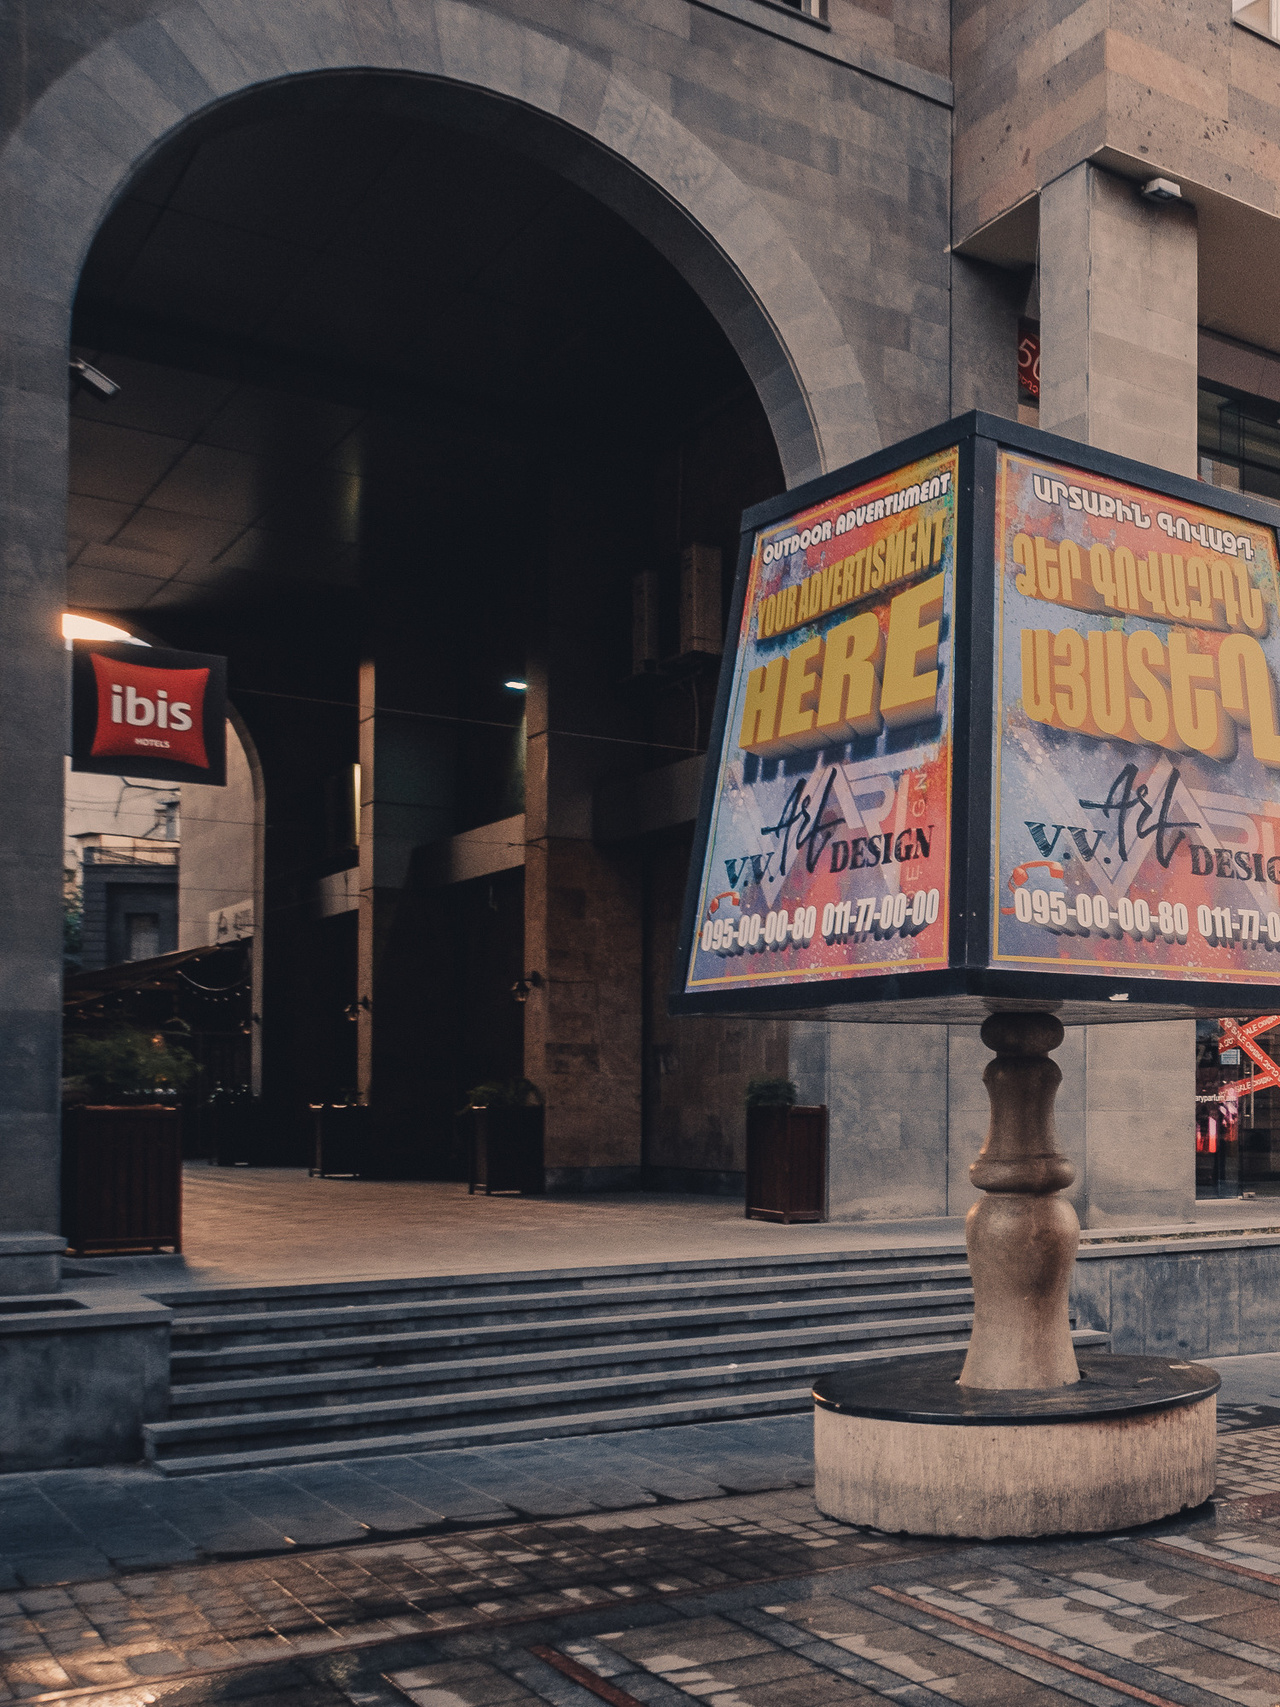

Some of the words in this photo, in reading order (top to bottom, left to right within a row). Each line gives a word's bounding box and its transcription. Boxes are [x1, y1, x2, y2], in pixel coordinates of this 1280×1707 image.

[762, 519, 833, 566] OUTDOOR
[835, 471, 951, 540] ADVERTISMENT
[757, 584, 799, 640] YOUR
[797, 508, 947, 624] ADVERTISMENT
[739, 572, 945, 752] HERE
[111, 683, 193, 732] ibis
[134, 737, 171, 749] HOTELS
[829, 824, 935, 874] DESIGN
[701, 905, 817, 953] 095-00-00-80
[821, 888, 940, 938] 011-77-00-00
[1014, 887, 1190, 936] 095-00-00-80
[1243, 1024, 1259, 1036] ALE
